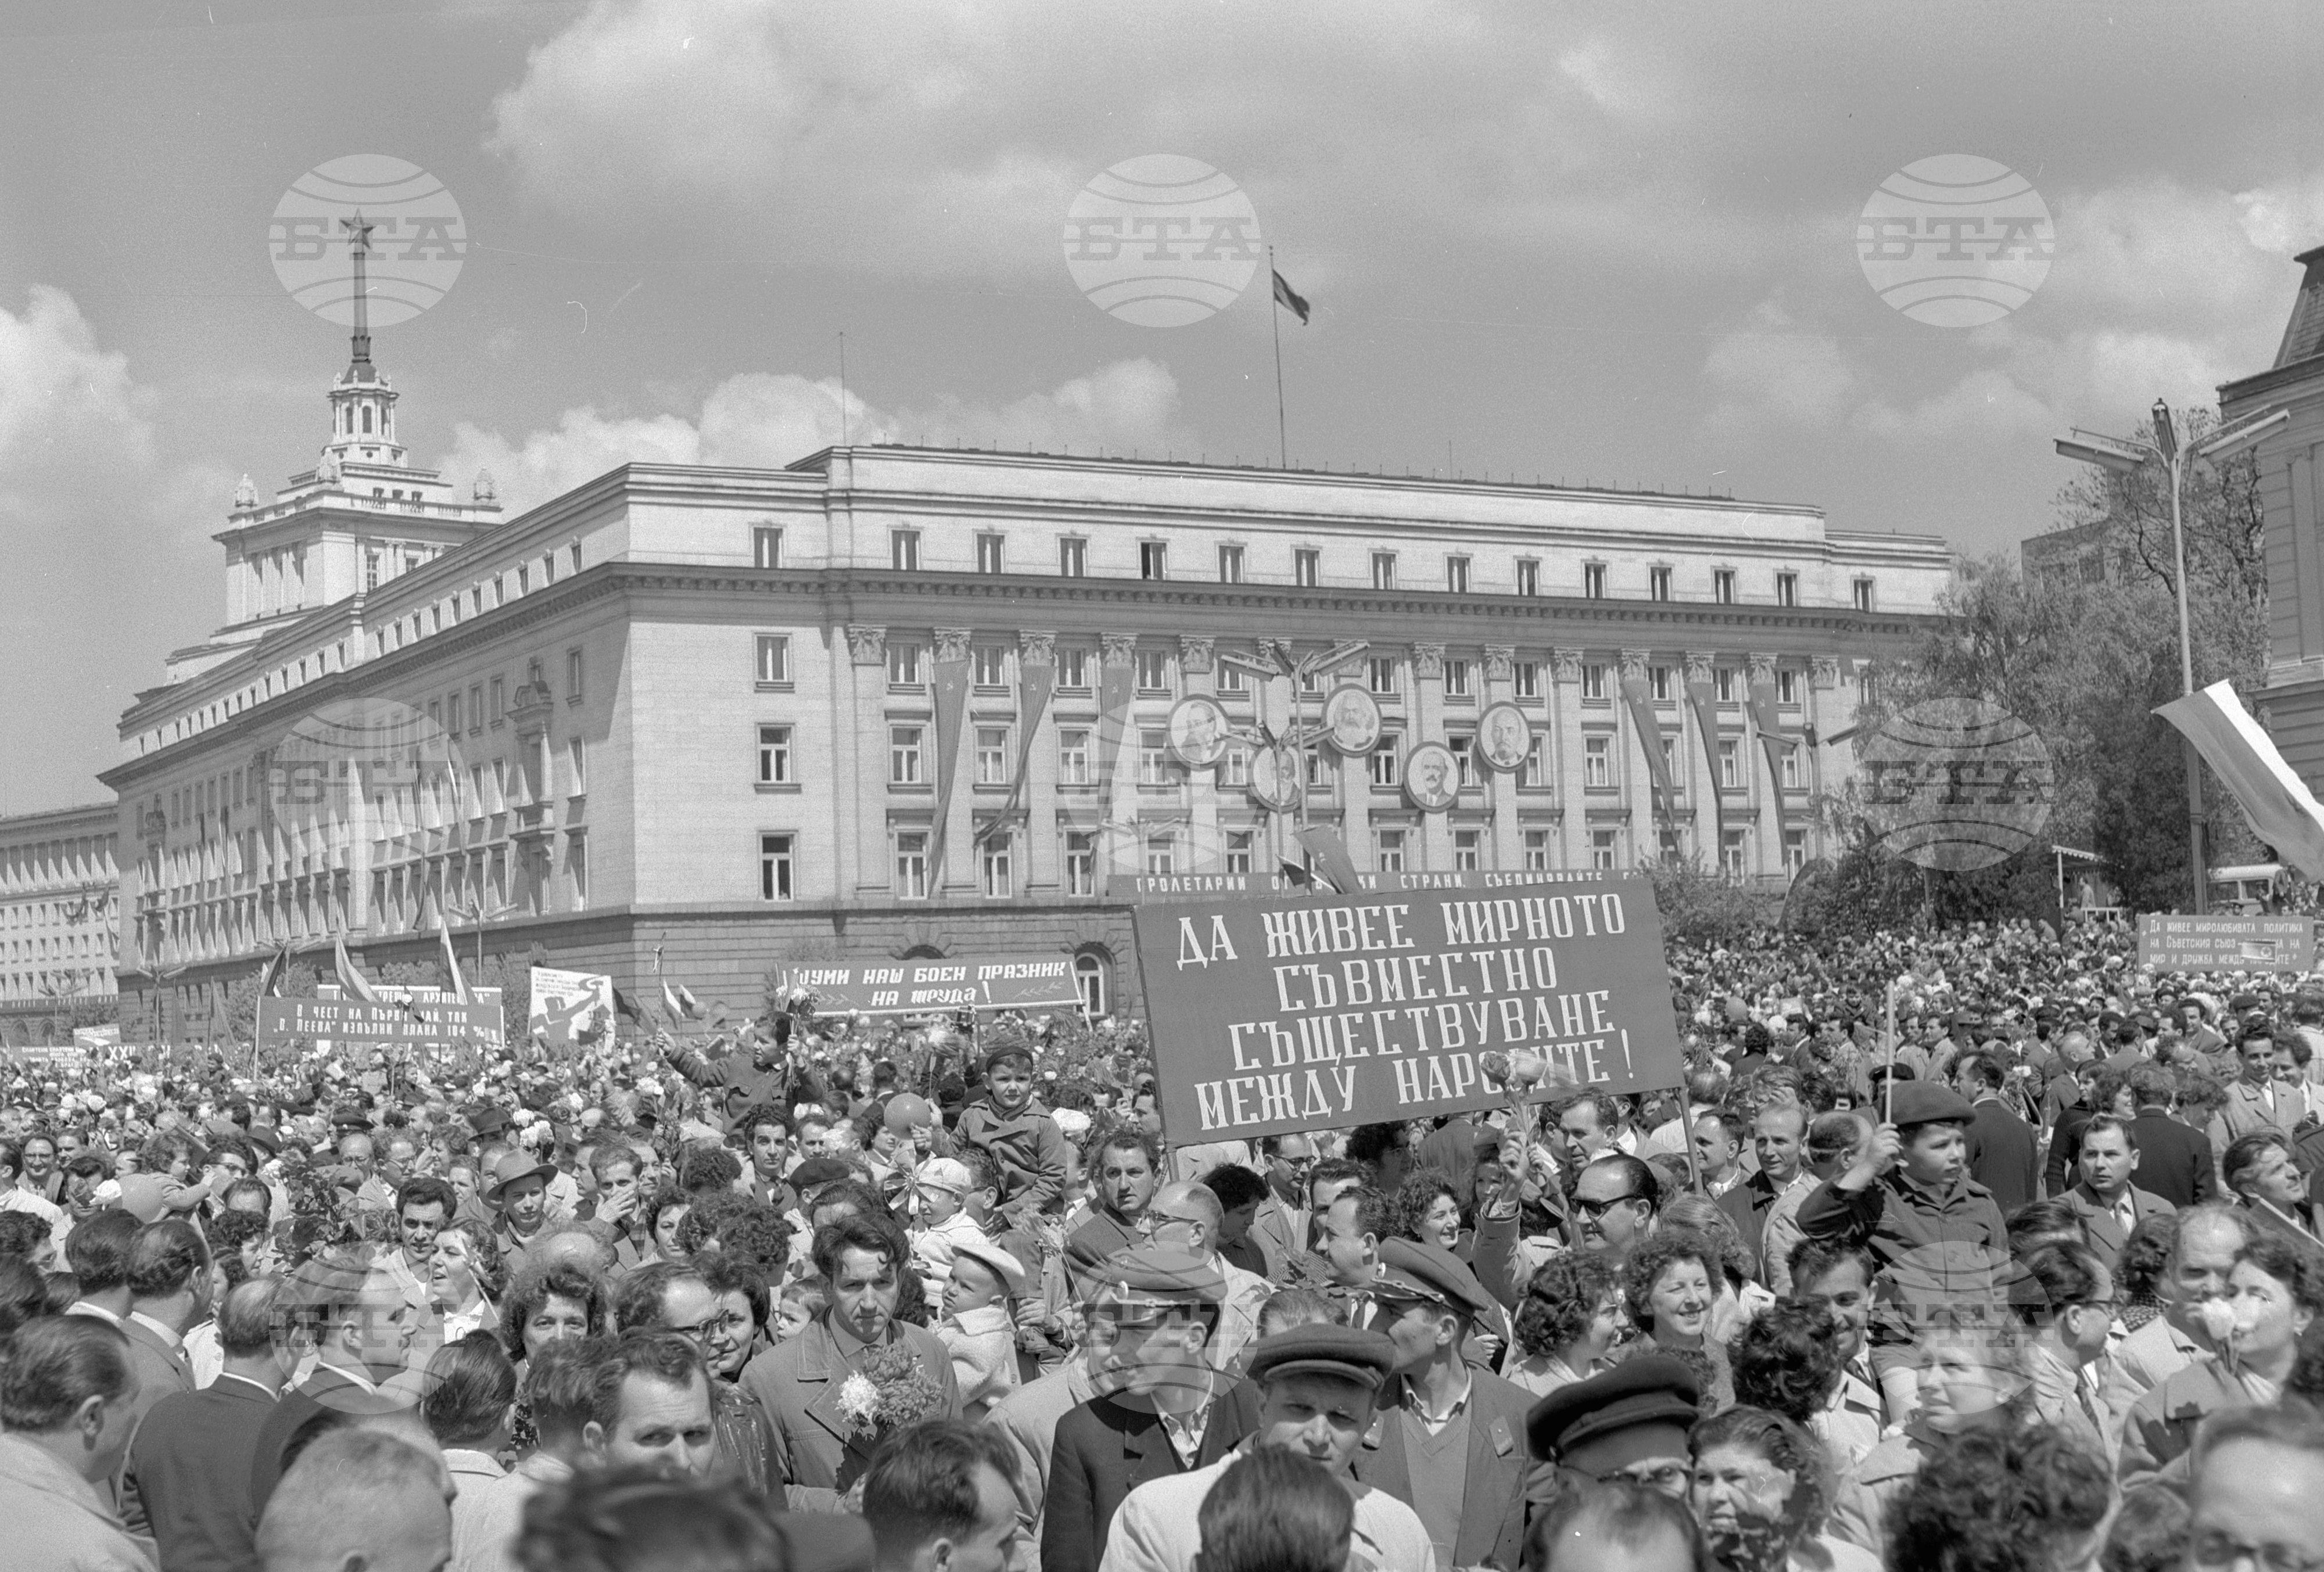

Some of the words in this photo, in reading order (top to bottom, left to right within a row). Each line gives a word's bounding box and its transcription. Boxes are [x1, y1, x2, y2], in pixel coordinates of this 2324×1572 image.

[1176, 914, 1238, 971] ДА
[1261, 905, 1416, 959] ЖИВЕЕ
[1440, 893, 1626, 946] МИРНОТО
[862, 968, 905, 984] НАШ
[914, 966, 966, 983] БОЕН
[978, 961, 1067, 980] ПРАЗНИК
[1273, 946, 1558, 1013] СЪВМЕСТНО
[297, 1004, 303, 1017] В
[313, 1006, 339, 1019] ЧЕСТ
[349, 1007, 362, 1020] НА
[871, 990, 899, 1007] НА
[342, 1021, 393, 1035] ИЗПЪЛНИ
[403, 1023, 438, 1036] ПЛАНА
[447, 1024, 466, 1037] 104
[1228, 989, 1616, 1071] СЪЩЕСТВУВАНЕ
[1195, 1065, 1356, 1130] МЕЖДУ
